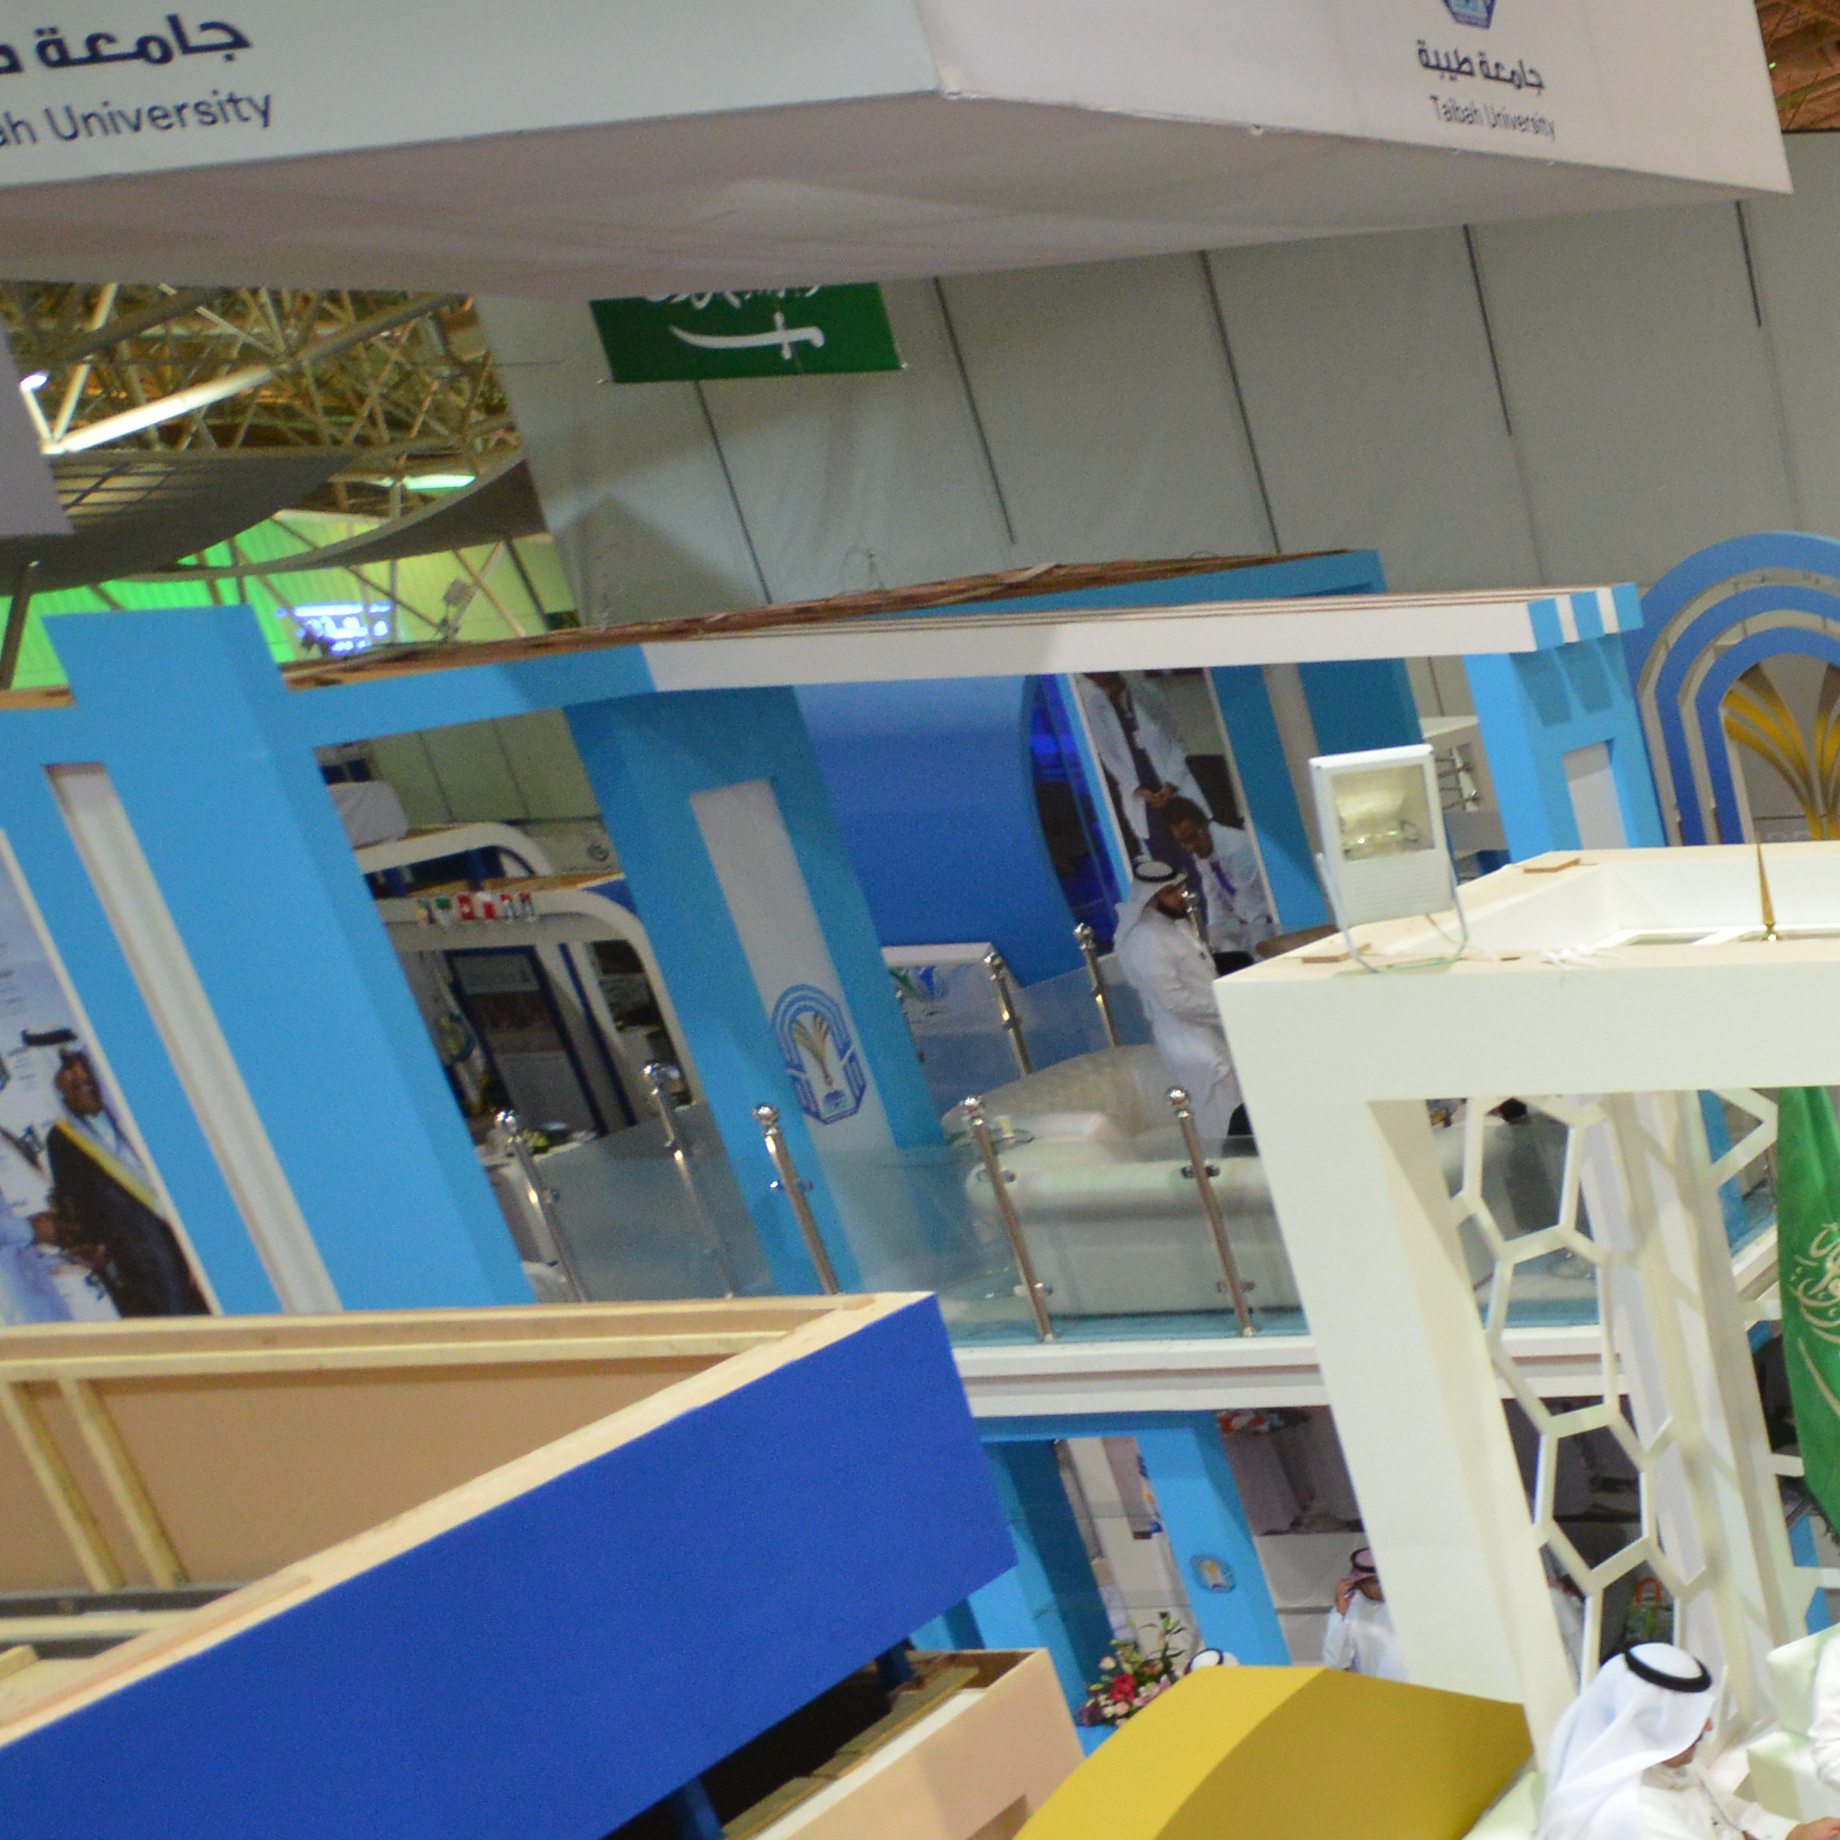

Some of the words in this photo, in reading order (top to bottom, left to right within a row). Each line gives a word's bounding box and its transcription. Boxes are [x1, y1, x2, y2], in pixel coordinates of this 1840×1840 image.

[34, 13, 252, 68] جامعة
[1416, 39, 1476, 82] طيبة
[1478, 51, 1545, 96] جامعة
[44, 89, 272, 142] University
[1430, 94, 1484, 126] Taibah
[1484, 102, 1556, 142] University
